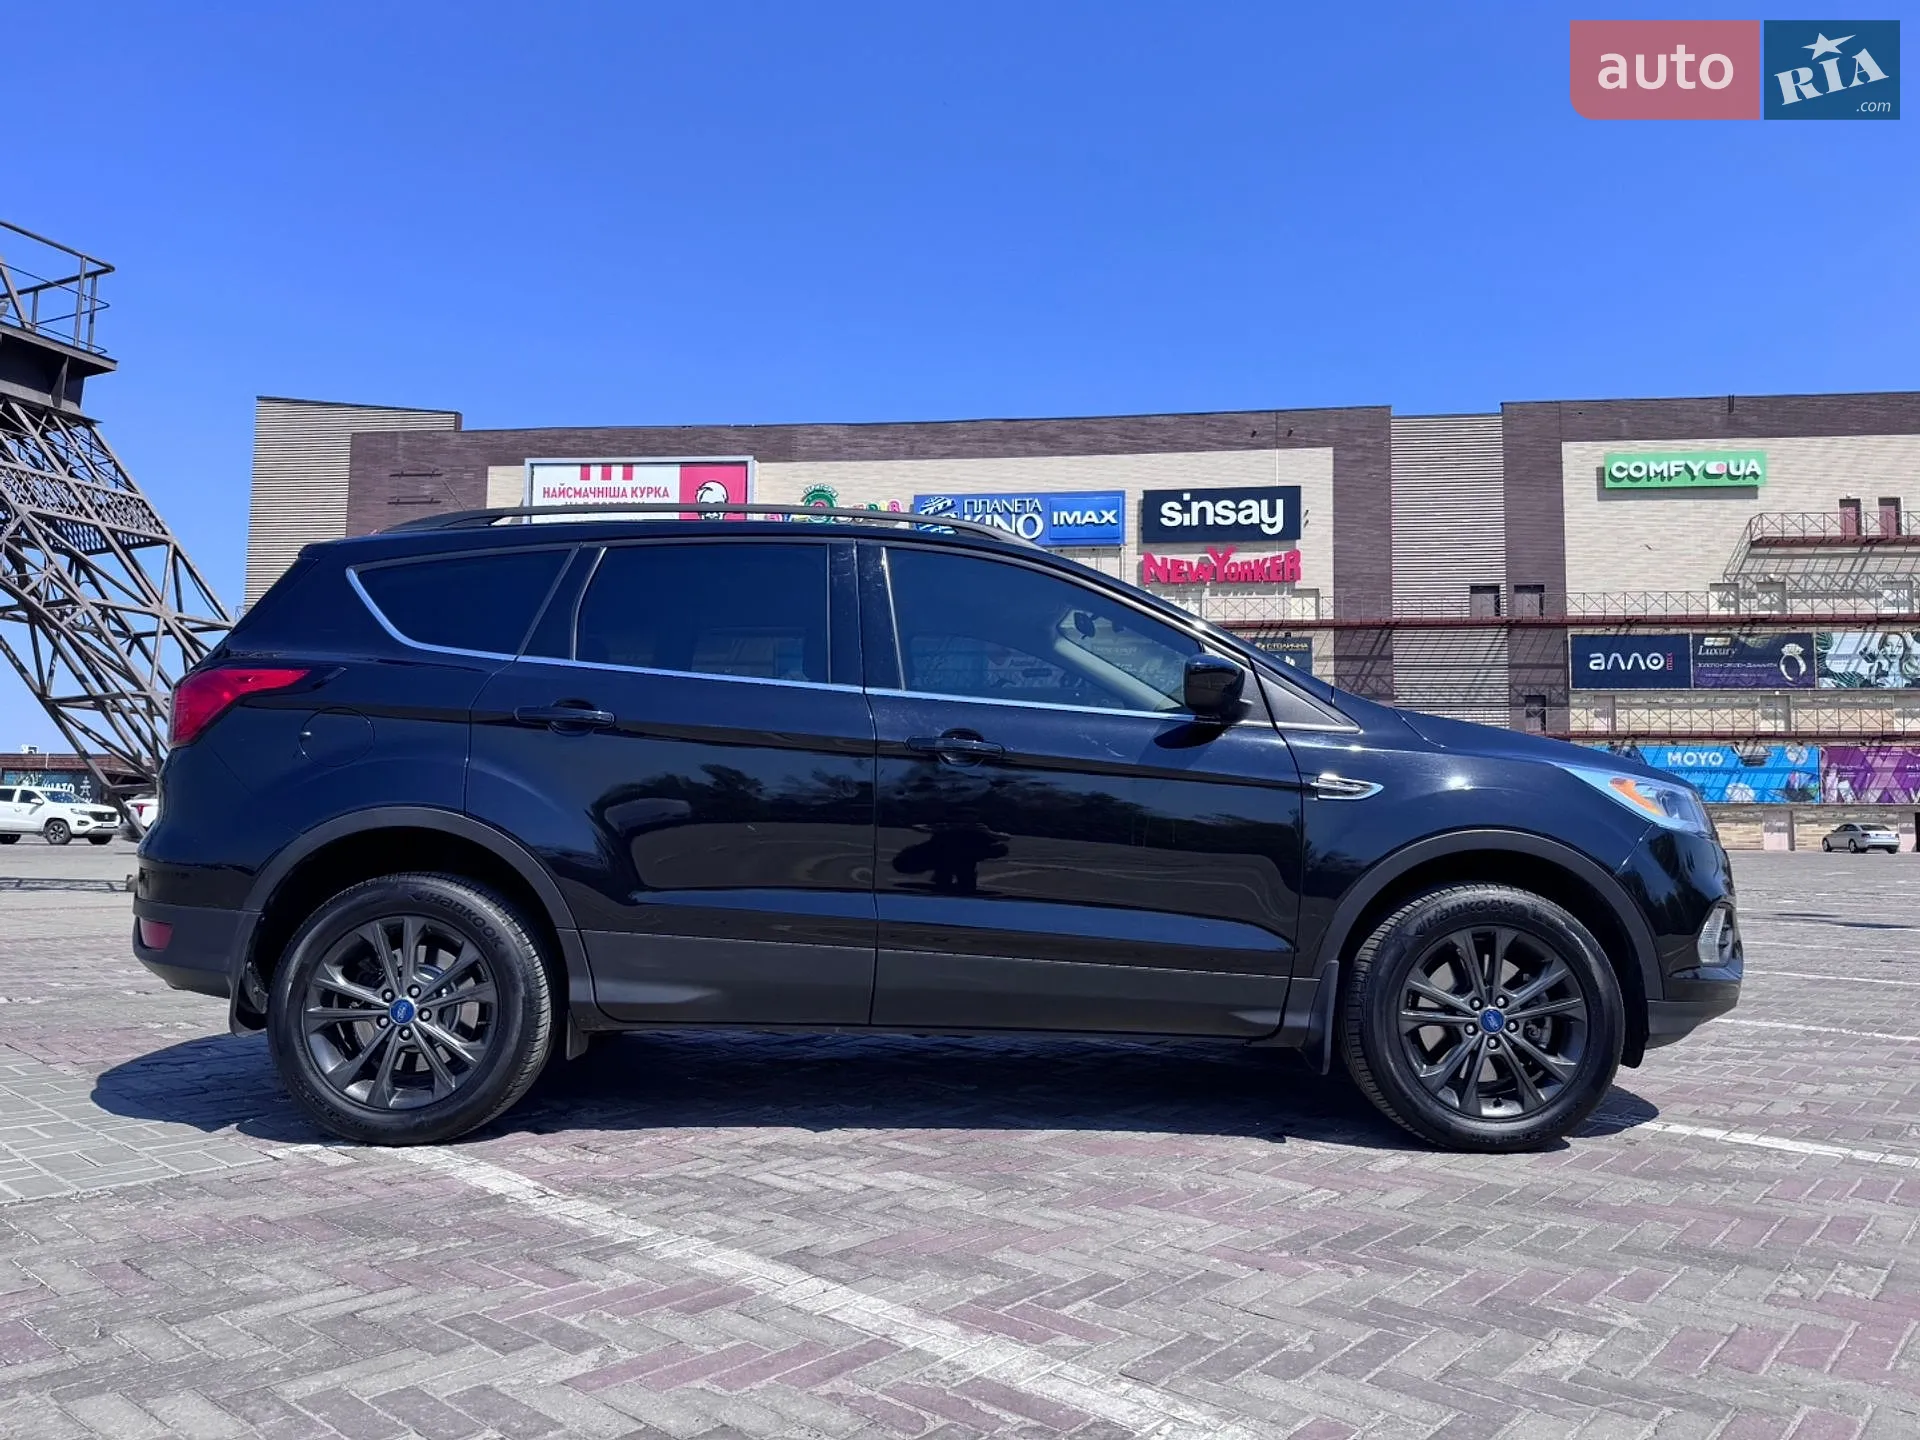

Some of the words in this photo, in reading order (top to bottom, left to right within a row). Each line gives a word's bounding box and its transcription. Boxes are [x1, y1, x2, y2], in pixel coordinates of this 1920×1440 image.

[1610, 460, 1706, 479] COMFY
[542, 482, 628, 499] НАЙСМАЧНІША
[630, 485, 670, 499] КУРКА
[963, 497, 1043, 514] ПЛАНЕТА
[1160, 492, 1284, 535] sinsay
[963, 512, 1045, 540] NO
[1052, 509, 1119, 526] IMAX
[1667, 751, 1724, 767] MOYO
